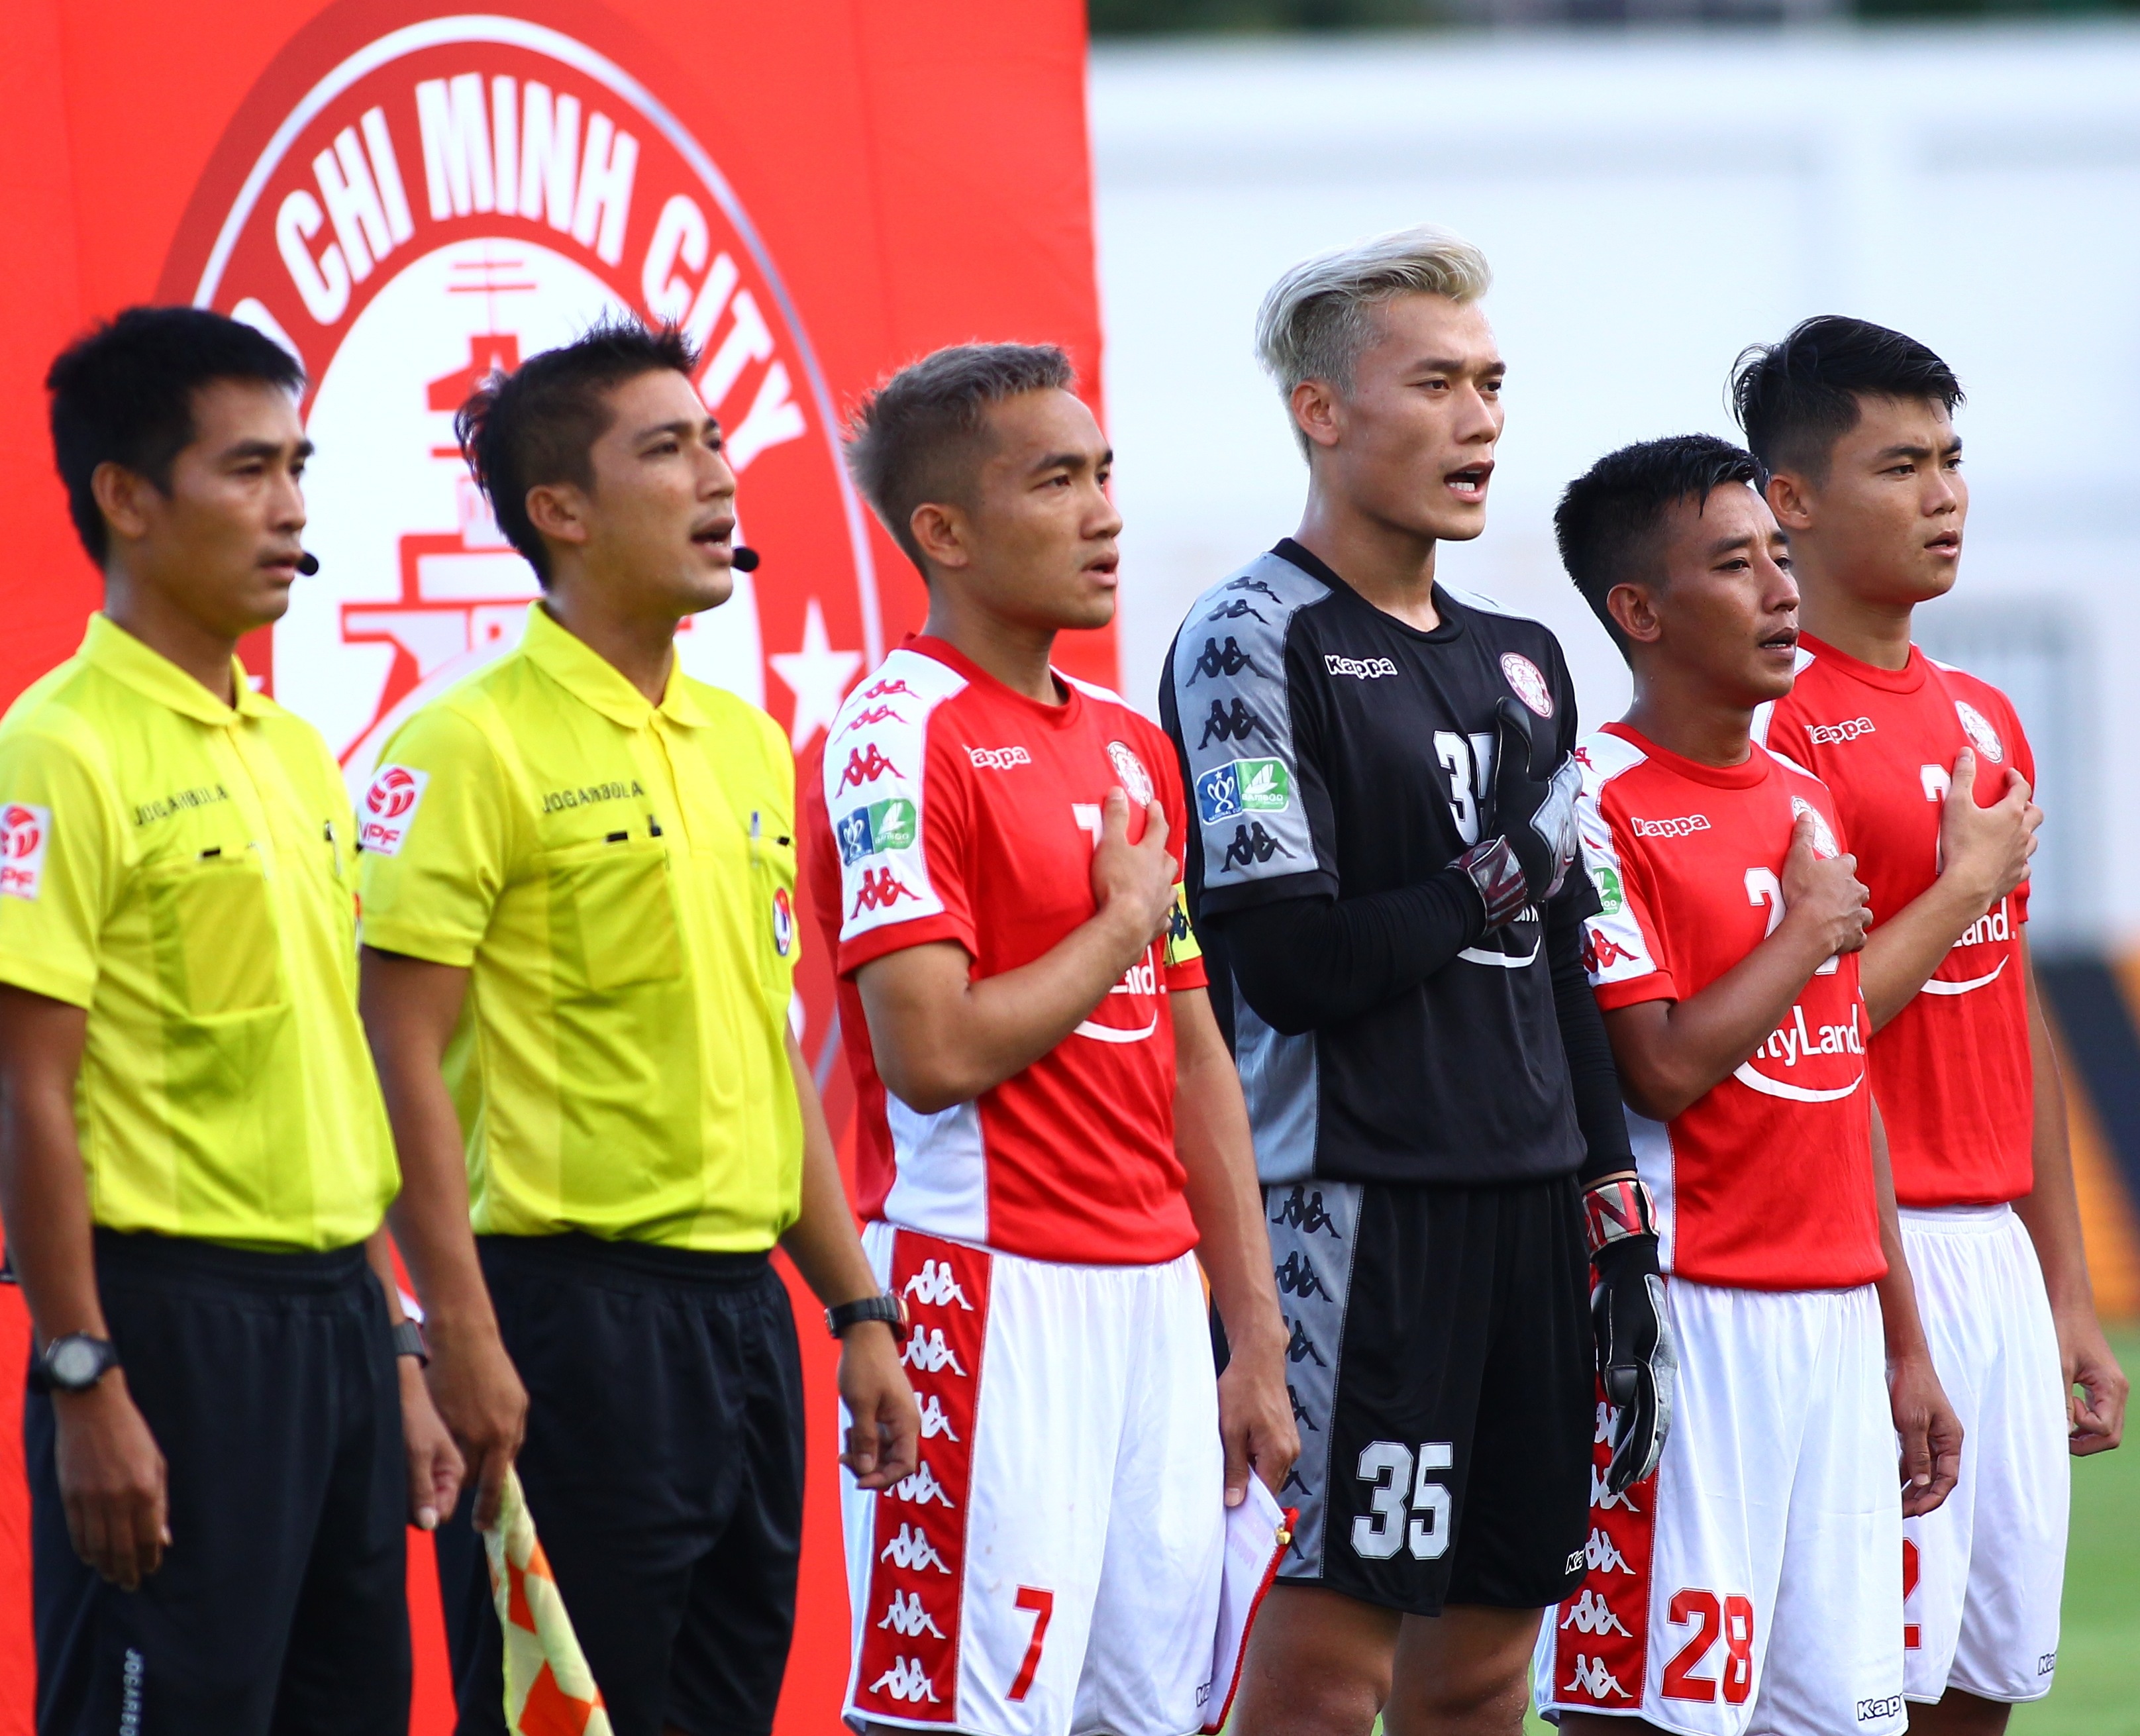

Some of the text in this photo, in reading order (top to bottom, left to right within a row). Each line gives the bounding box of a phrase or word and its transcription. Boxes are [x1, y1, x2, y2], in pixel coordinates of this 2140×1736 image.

[276, 72, 806, 472] CHI MINH CITY
[1325, 654, 1398, 680] Kappa
[962, 746, 1032, 770] appa
[1351, 1440, 1454, 1560] 35
[1005, 1584, 1054, 1703] 7
[1660, 1587, 1755, 1706] 28
[1857, 1694, 1903, 1721] Kap
